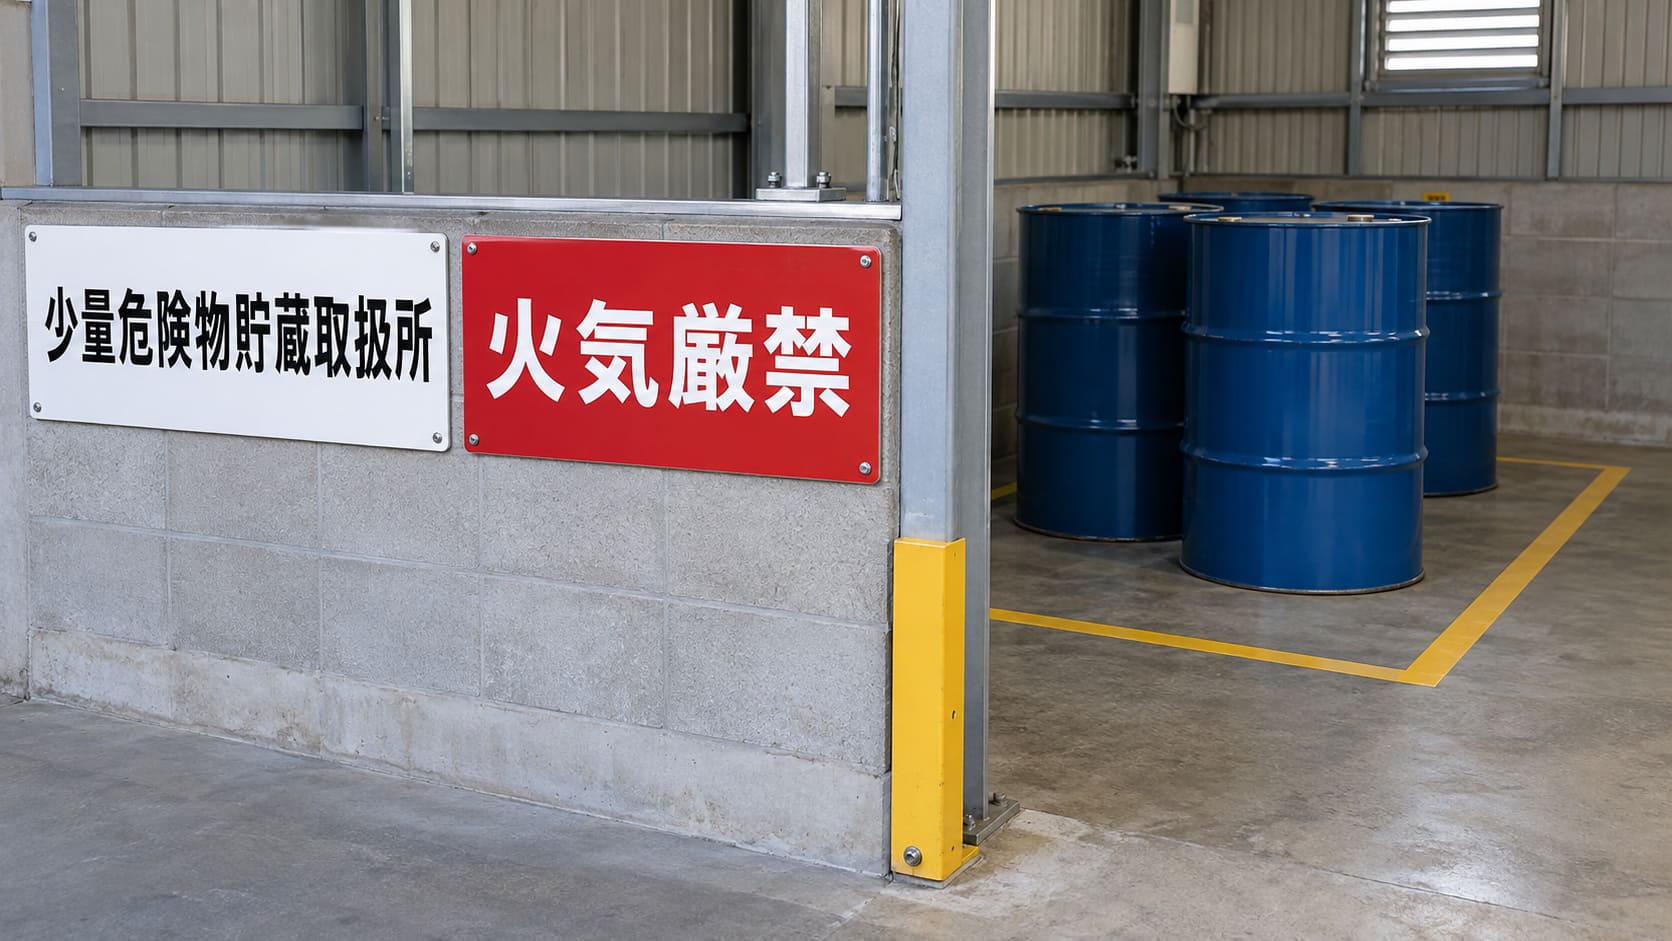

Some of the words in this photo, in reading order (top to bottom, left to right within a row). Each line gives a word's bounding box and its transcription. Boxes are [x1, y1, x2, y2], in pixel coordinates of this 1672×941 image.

[45, 286, 433, 383] 少量危険物貯蔵取扱所
[486, 297, 852, 418] 火気厳禁
